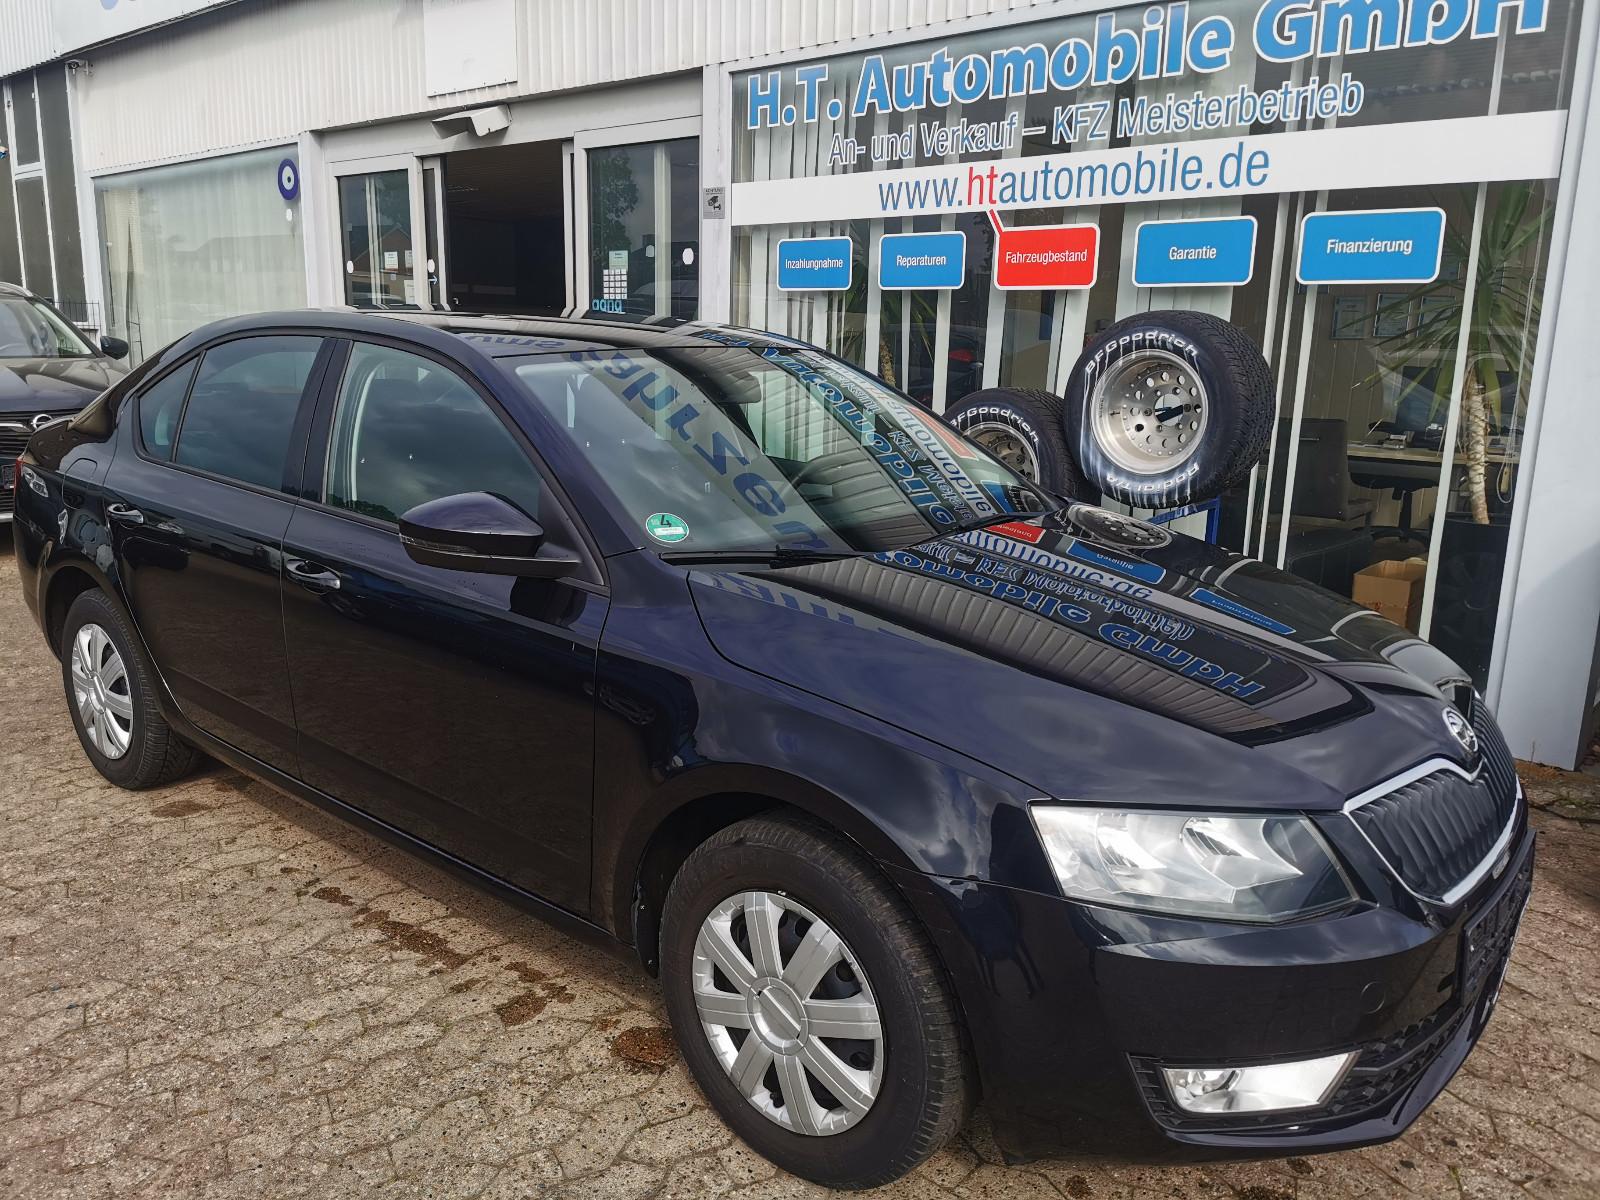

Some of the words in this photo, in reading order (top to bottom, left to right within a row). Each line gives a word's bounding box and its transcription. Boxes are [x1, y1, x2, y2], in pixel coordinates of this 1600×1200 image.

[748, 64, 842, 129] H.T.
[852, 1, 1235, 117] Automobile
[828, 133, 866, 166] An-
[871, 132, 913, 160] und
[921, 112, 1018, 158] Verkauf
[1053, 102, 1110, 145] KFZ
[1117, 73, 1364, 138] Meisterbetrieb
[879, 142, 1270, 211] www.htautomobile.de
[1168, 245, 1217, 261] Garantie
[1326, 238, 1413, 255] Finanzierung
[785, 257, 843, 271] Inzahlungnahme
[896, 254, 946, 268] Reparaturen
[1005, 249, 1088, 264] Fahrzeugbestand
[1085, 331, 1198, 373] BFGoodrich
